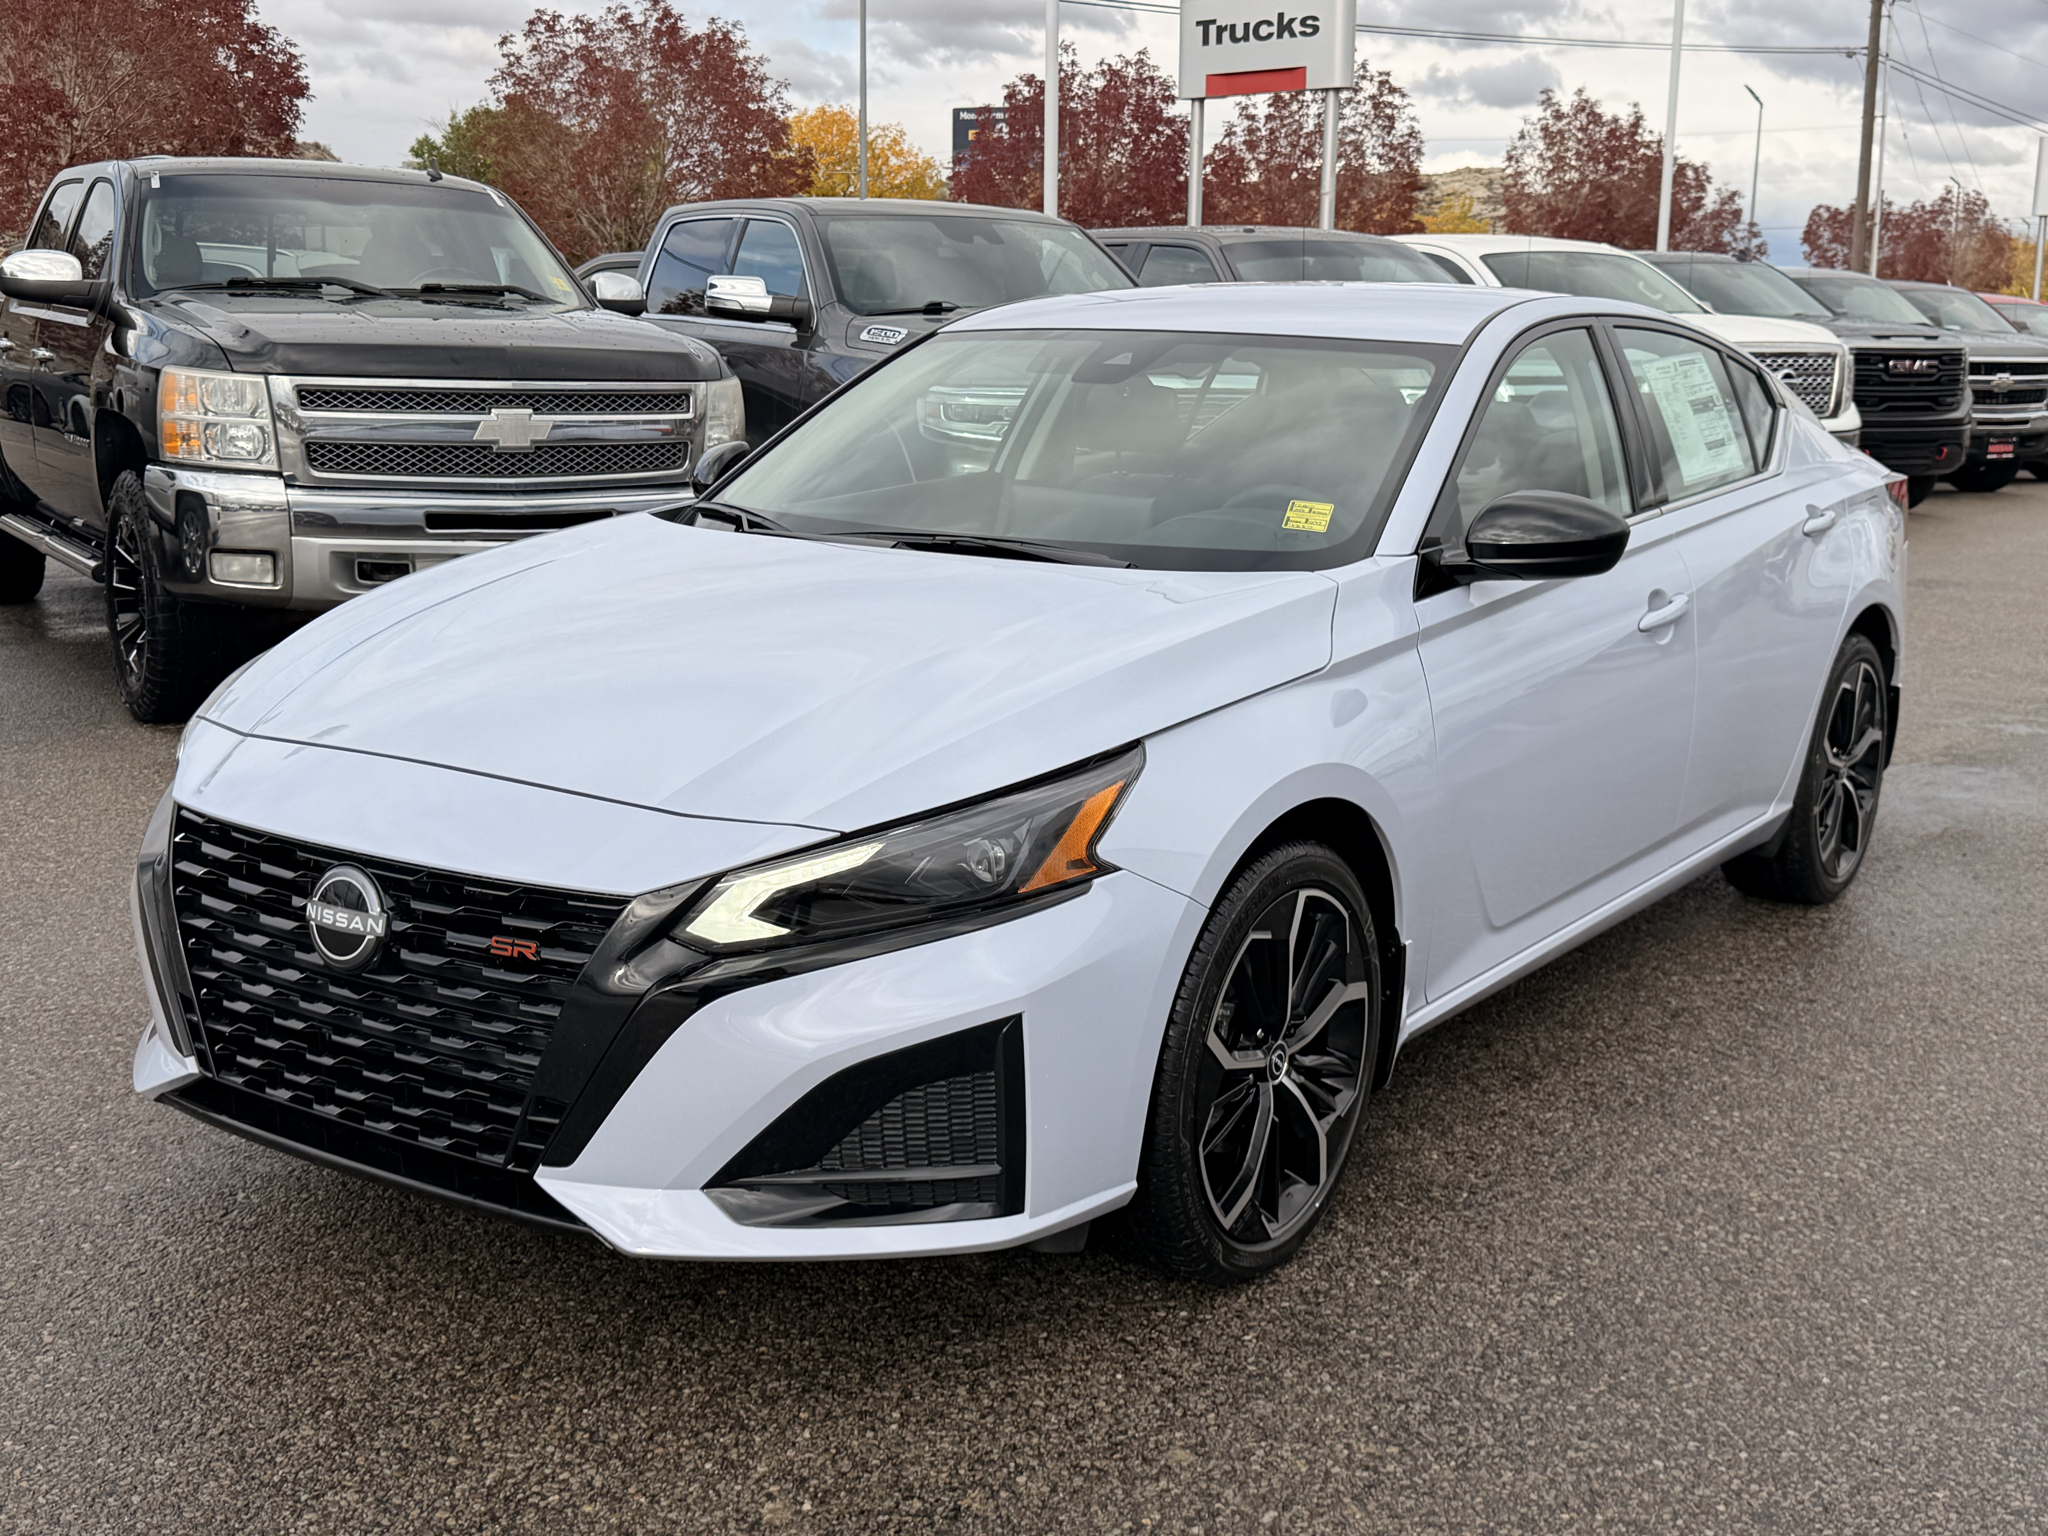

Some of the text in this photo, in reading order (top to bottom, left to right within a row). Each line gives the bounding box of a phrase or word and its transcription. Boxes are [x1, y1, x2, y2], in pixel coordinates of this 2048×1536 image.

[1195, 12, 1320, 47] Trucks
[869, 328, 900, 338] 1500
[1889, 359, 1938, 374] GMC
[306, 902, 384, 934] NISSAN
[490, 936, 538, 961] SR
[1181, 1171, 1209, 1247] TURANZA
